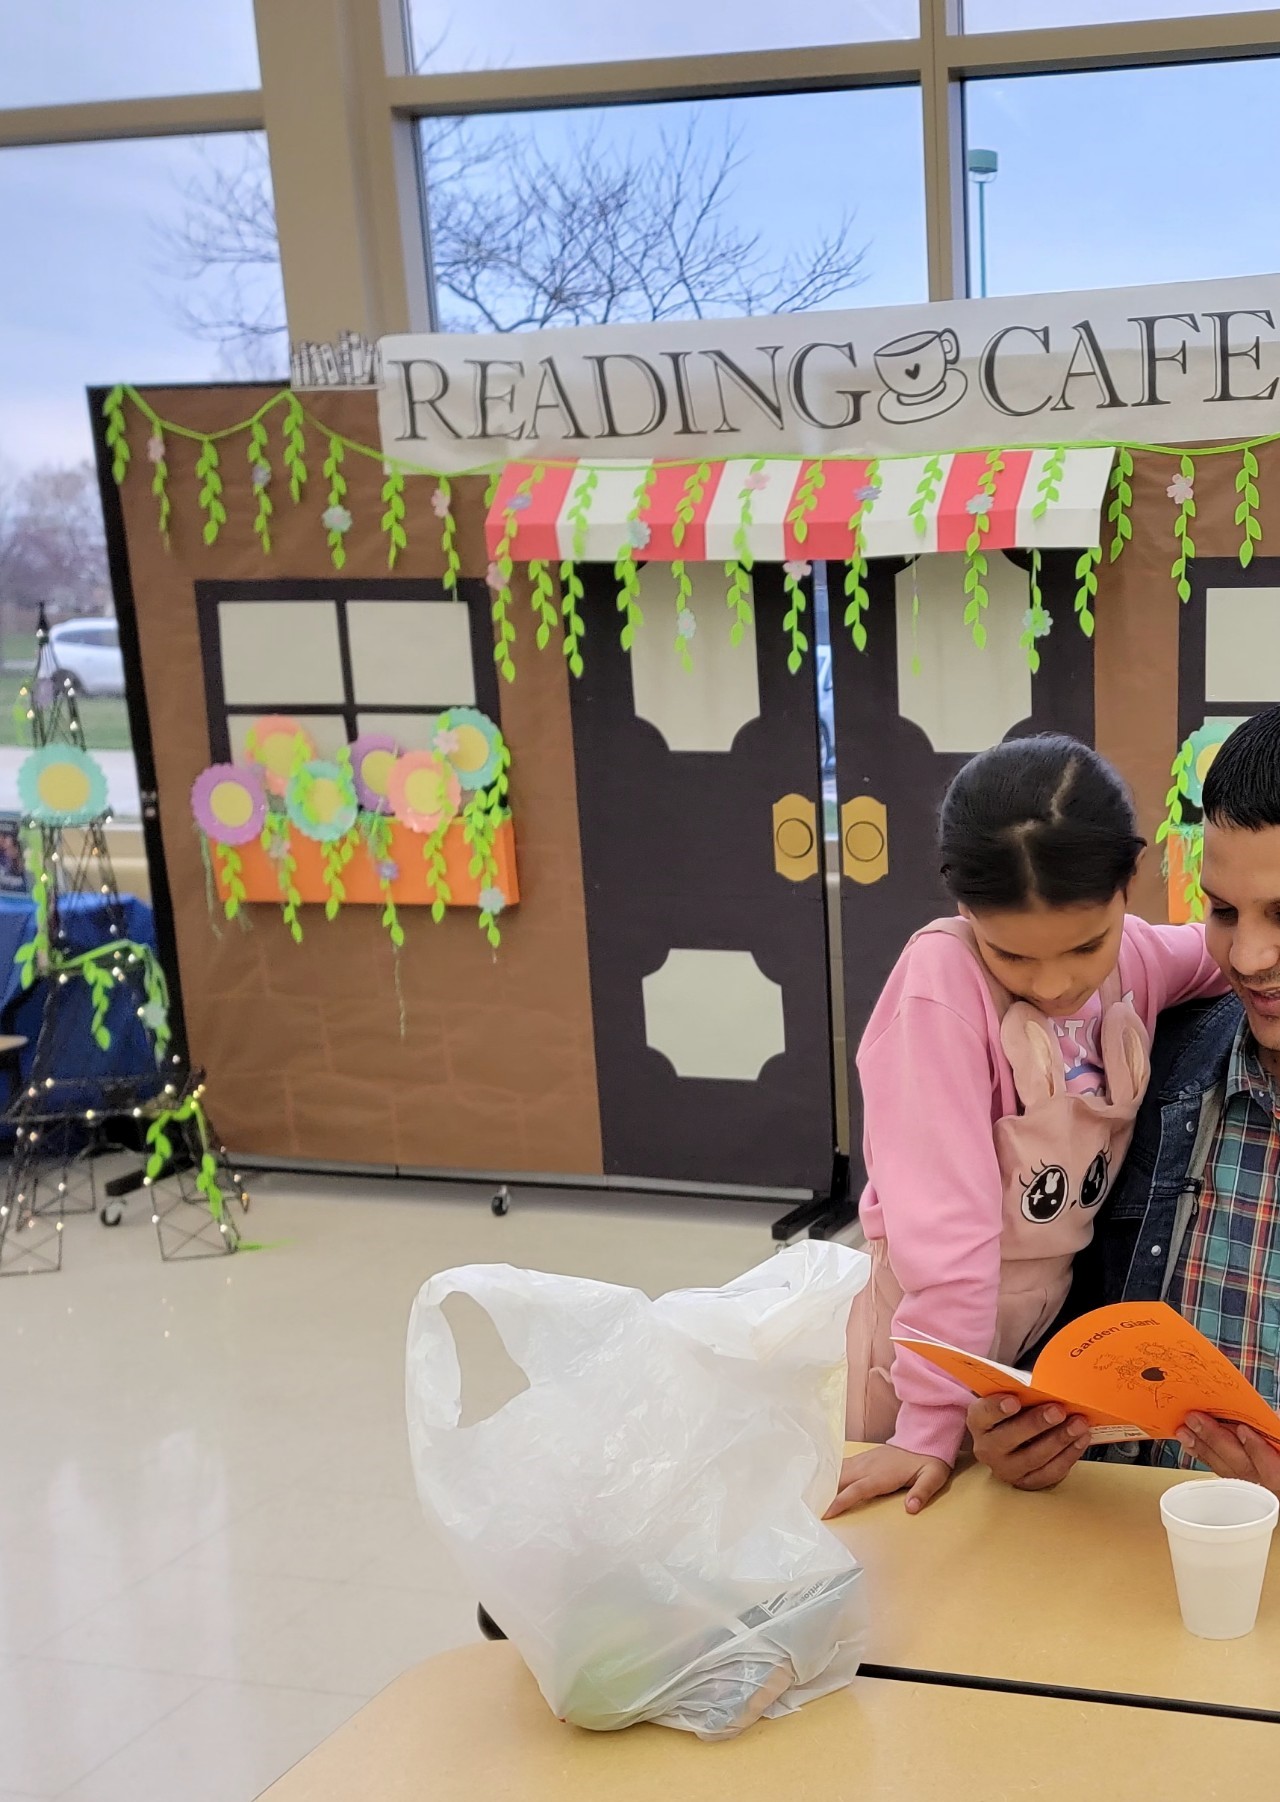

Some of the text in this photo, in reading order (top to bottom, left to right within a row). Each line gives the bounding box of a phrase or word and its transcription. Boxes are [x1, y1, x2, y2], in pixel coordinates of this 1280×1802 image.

[394, 308, 1278, 443] READING CAFE
[1070, 1318, 1160, 1358] Garden Giant
